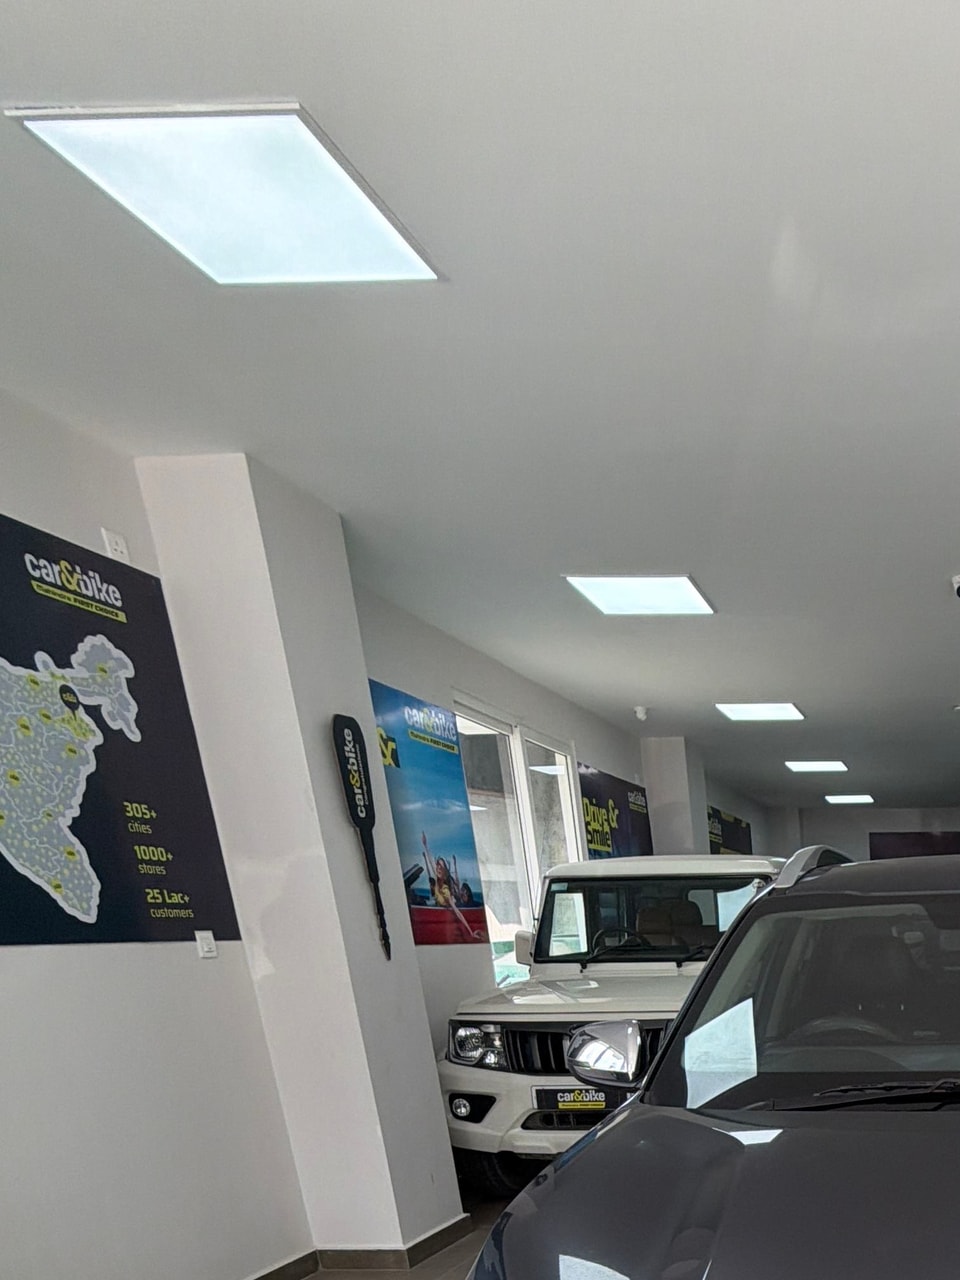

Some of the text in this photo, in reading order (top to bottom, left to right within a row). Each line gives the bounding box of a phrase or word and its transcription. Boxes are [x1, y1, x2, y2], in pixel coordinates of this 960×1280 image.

[24, 553, 122, 607] car&bike
[404, 706, 457, 741] car&bike
[344, 728, 367, 818] car&bike
[122, 801, 158, 819] 305+
[608, 798, 619, 829] &
[127, 820, 153, 834] cities
[133, 845, 174, 862] 1000+
[138, 863, 167, 875] stores
[144, 888, 190, 904] 25 Lac+
[150, 906, 195, 918] customers
[557, 1089, 605, 1102] car&bike
